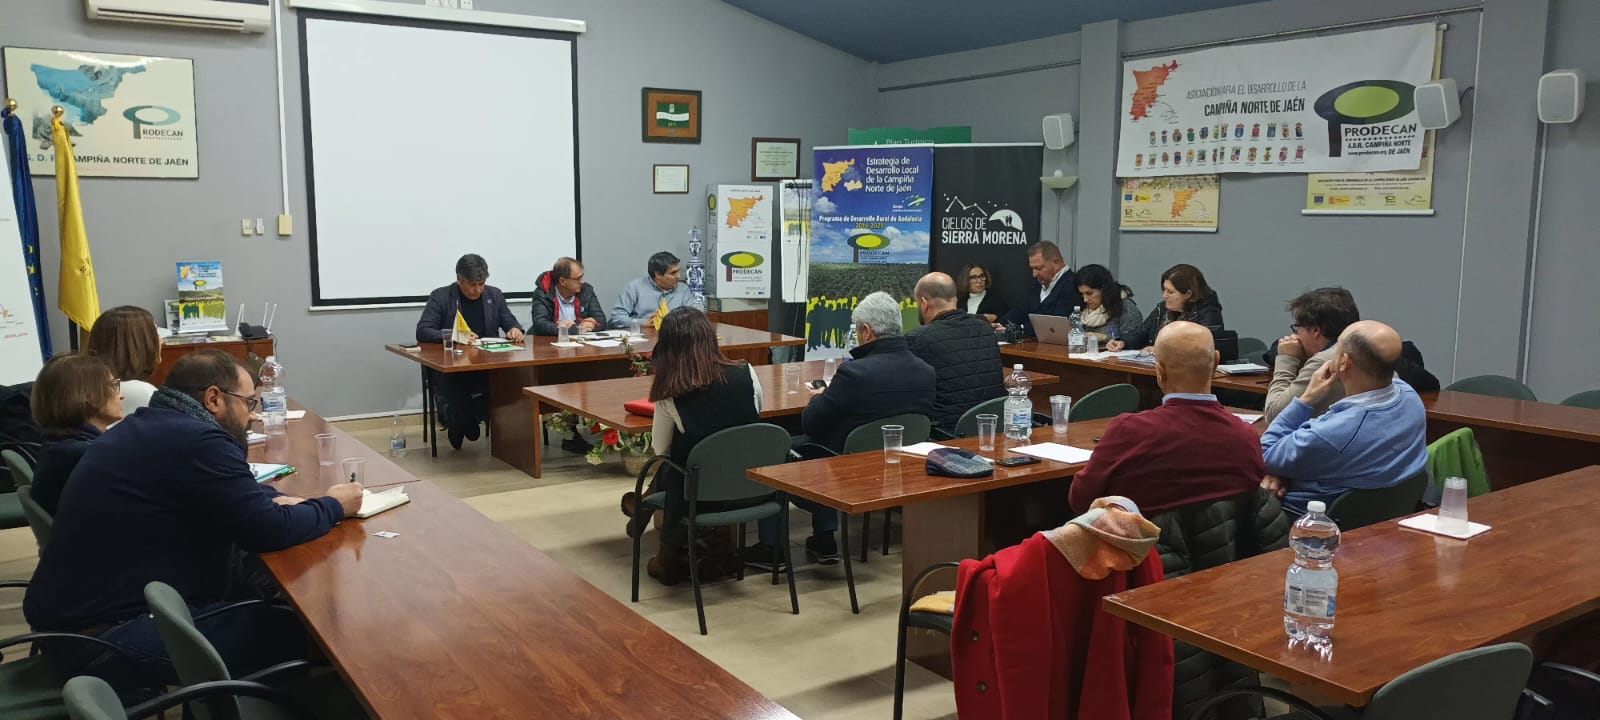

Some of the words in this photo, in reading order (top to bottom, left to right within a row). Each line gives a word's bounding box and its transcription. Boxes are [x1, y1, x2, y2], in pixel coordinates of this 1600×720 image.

[1298, 80, 1306, 91] LA
[1240, 100, 1269, 114] NORTE
[1270, 99, 1281, 113] DE
[1282, 95, 1305, 112] JAÉN
[1344, 123, 1417, 137] PRODECAN
[73, 155, 111, 164] AMPIÑA
[113, 156, 147, 165] NORTE
[149, 157, 162, 166] DE
[866, 157, 897, 166] Estrategia
[901, 156, 911, 165] de
[866, 166, 900, 174] Desarrollo
[901, 165, 919, 174] Local
[865, 175, 872, 183] de
[876, 175, 882, 183] la
[884, 174, 915, 185] Campiña
[865, 184, 884, 193] Norte
[886, 184, 895, 192] de
[896, 183, 912, 194] Jaén
[818, 215, 843, 223] Programa
[942, 217, 974, 230] CIELOS
[975, 217, 988, 230] DE
[942, 230, 980, 244] SIERRA
[982, 231, 1027, 245] MORENA
